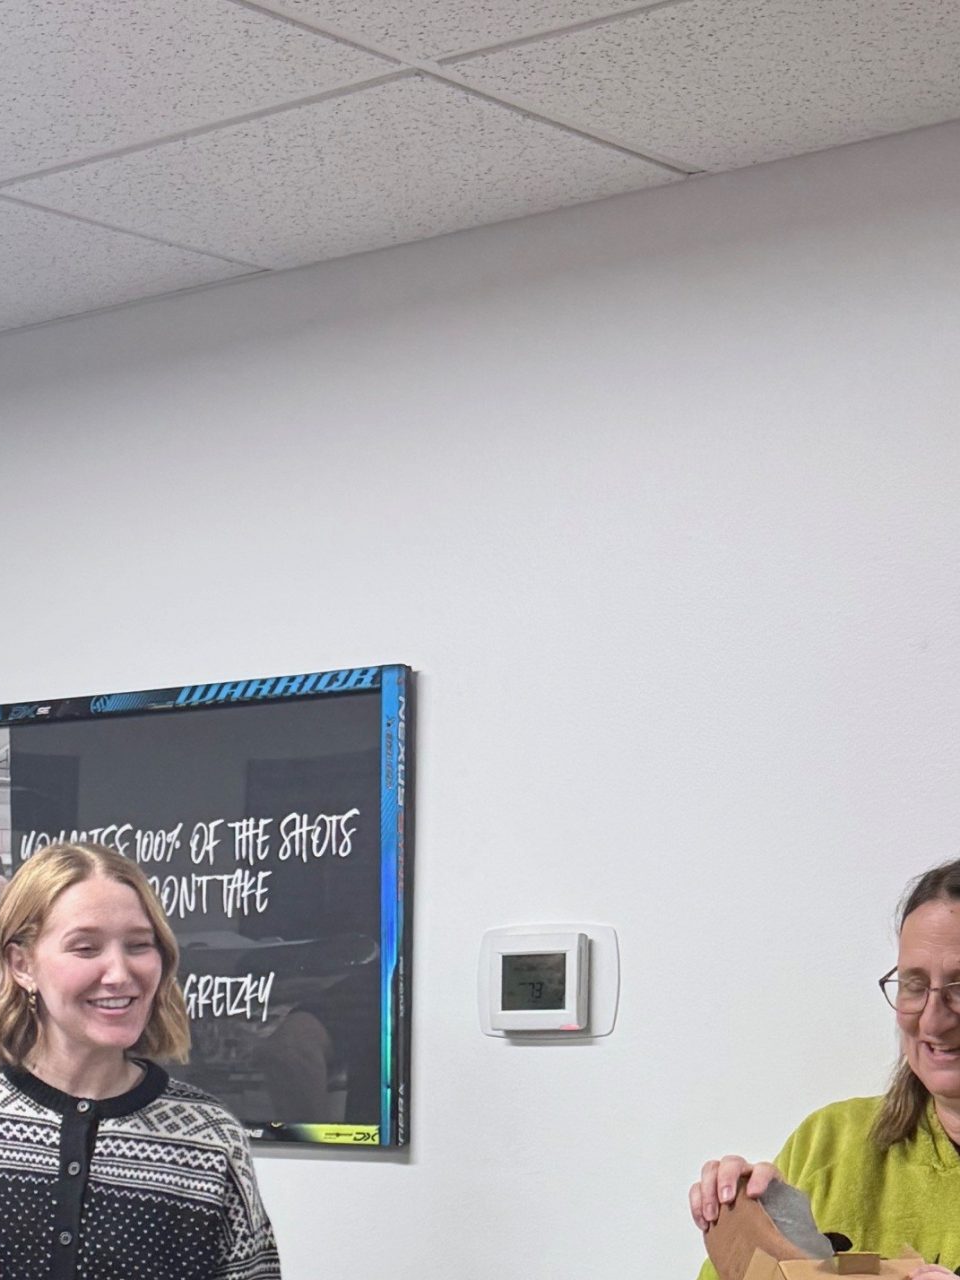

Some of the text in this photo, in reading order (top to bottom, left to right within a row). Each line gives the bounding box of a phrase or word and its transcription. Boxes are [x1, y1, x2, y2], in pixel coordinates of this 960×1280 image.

[175, 666, 381, 705] WARRIOR
[134, 822, 183, 864] 100%
[190, 819, 224, 865] OF
[227, 817, 273, 866] THE
[278, 808, 360, 863] SHOTS
[216, 868, 272, 918] TAKE
[183, 971, 275, 1022] GRETZKY
